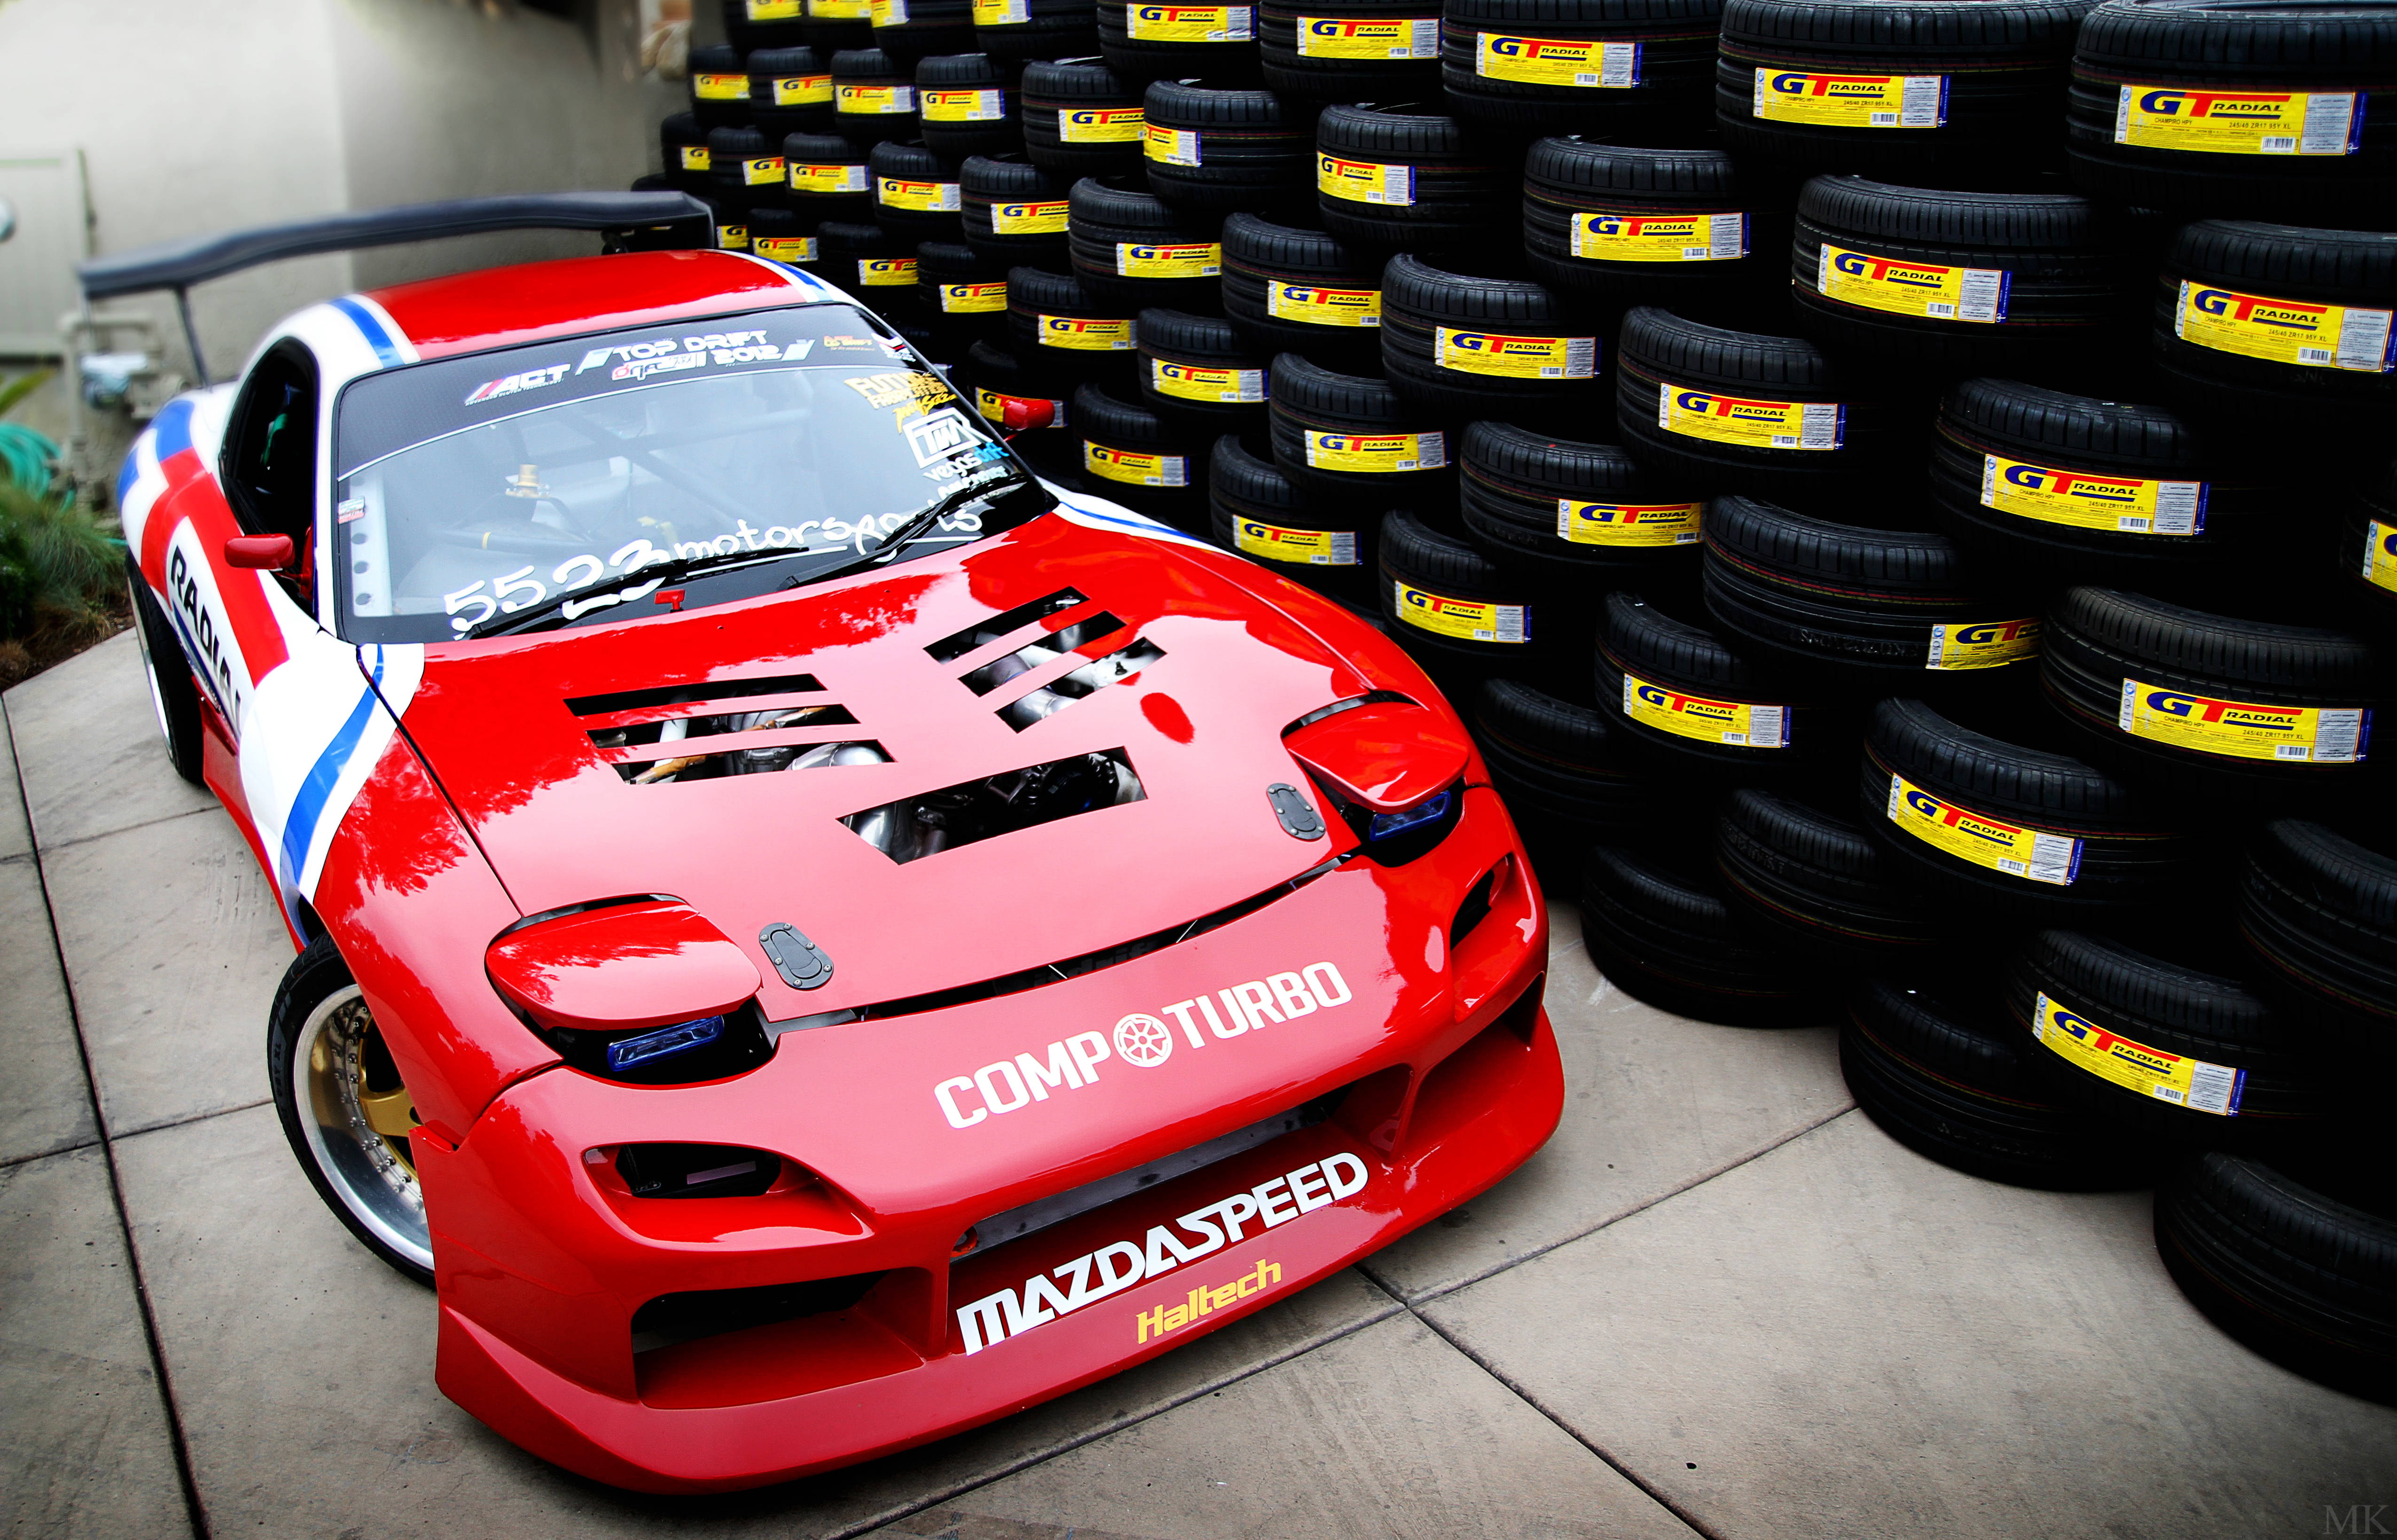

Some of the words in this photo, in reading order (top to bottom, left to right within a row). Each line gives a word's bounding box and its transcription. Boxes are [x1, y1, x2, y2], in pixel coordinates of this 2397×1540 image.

[1140, 7, 1177, 22] GT
[1312, 20, 1357, 36] GT
[1492, 38, 1541, 58] GT
[784, 79, 812, 89] GT
[1772, 73, 1830, 96] GT
[2139, 91, 2213, 117] GT
[2213, 103, 2284, 112] RADIAL
[1072, 112, 1109, 124] GT
[754, 159, 783, 169] GT
[1004, 205, 1038, 216] GT
[1588, 217, 1643, 235] GT
[1131, 246, 1172, 259] GT
[870, 260, 903, 271] GT
[1835, 253, 1889, 281] GT
[1889, 269, 1944, 282] RADIAL
[951, 285, 980, 297] GT
[1283, 287, 1328, 305] GT
[2194, 289, 2255, 321] GT
[2255, 309, 2320, 323] RADIAL
[1050, 319, 1086, 332] GT
[612, 340, 677, 361] TOP
[684, 330, 767, 352] DRIFT
[1452, 333, 1505, 353] GT
[711, 344, 783, 365] 2012
[489, 364, 570, 396] ACT
[1162, 365, 1194, 381] GT
[1678, 392, 1734, 416] GT
[1734, 407, 1787, 416] RADIAL
[1320, 436, 1363, 451] GT
[1092, 447, 1121, 463] GT
[2005, 465, 2073, 494] GT
[2073, 483, 2138, 495] RADIAL
[1579, 505, 1639, 523] GT
[1244, 524, 1281, 541] GT
[444, 539, 671, 640] 5523
[1406, 591, 1444, 612] GT
[1444, 605, 1483, 615] RADIAL
[1956, 624, 2020, 644] GT
[1638, 686, 1687, 712] GT
[1687, 704, 1735, 715] RADIAL
[2147, 691, 2226, 723] GT
[2226, 711, 2297, 724] RADIAL
[1907, 791, 1961, 827] GT
[1960, 820, 2016, 841] RADIAL
[934, 1031, 1111, 1128] COMP
[1162, 961, 1352, 1049] TURBO
[2054, 1011, 2115, 1052] GT
[2114, 1045, 2174, 1069] RADIAL
[956, 1152, 1369, 1356] MAZDASPEED
[1136, 1259, 1281, 1345] Haltech
